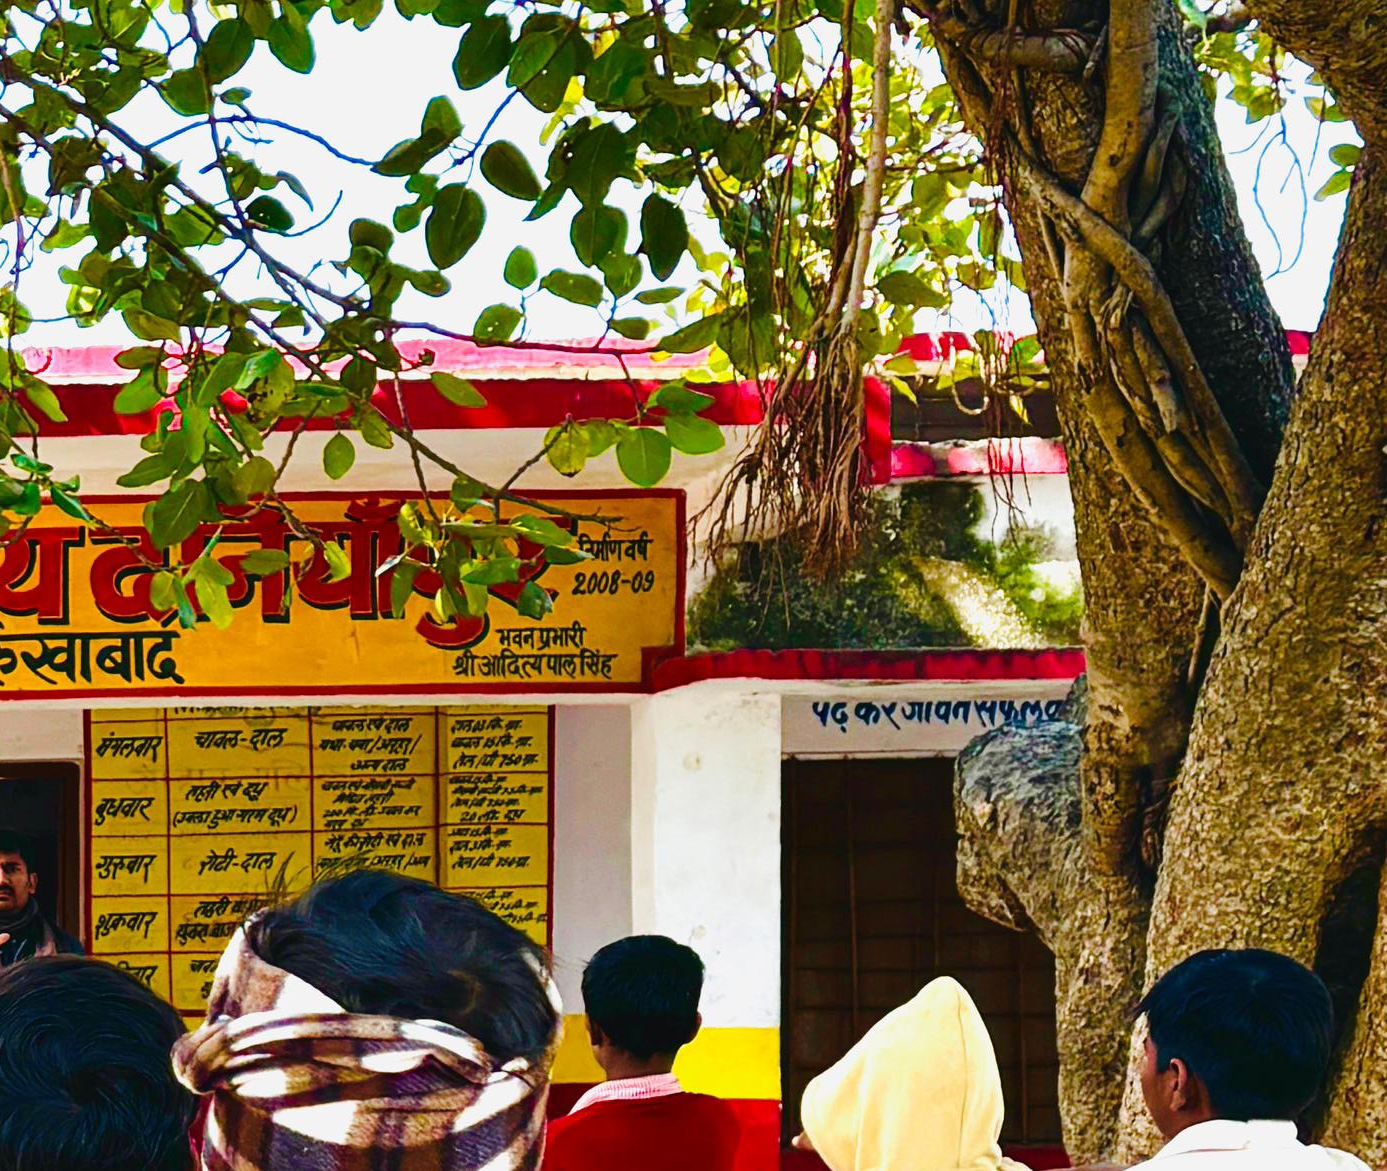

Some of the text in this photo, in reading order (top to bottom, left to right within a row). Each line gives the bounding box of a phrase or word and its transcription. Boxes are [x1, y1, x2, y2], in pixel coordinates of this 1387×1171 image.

[624, 531, 654, 561] वर्ष
[572, 569, 656, 595] 2008-09
[496, 620, 587, 651] भवन प्रभारी
[452, 648, 618, 680] श्री आदित्य पाल सिंह
[95, 731, 163, 763] मंगलवार
[94, 797, 155, 826] बुधवार
[95, 854, 158, 884] गुरुवार
[95, 911, 158, 941] शुक्रवार
